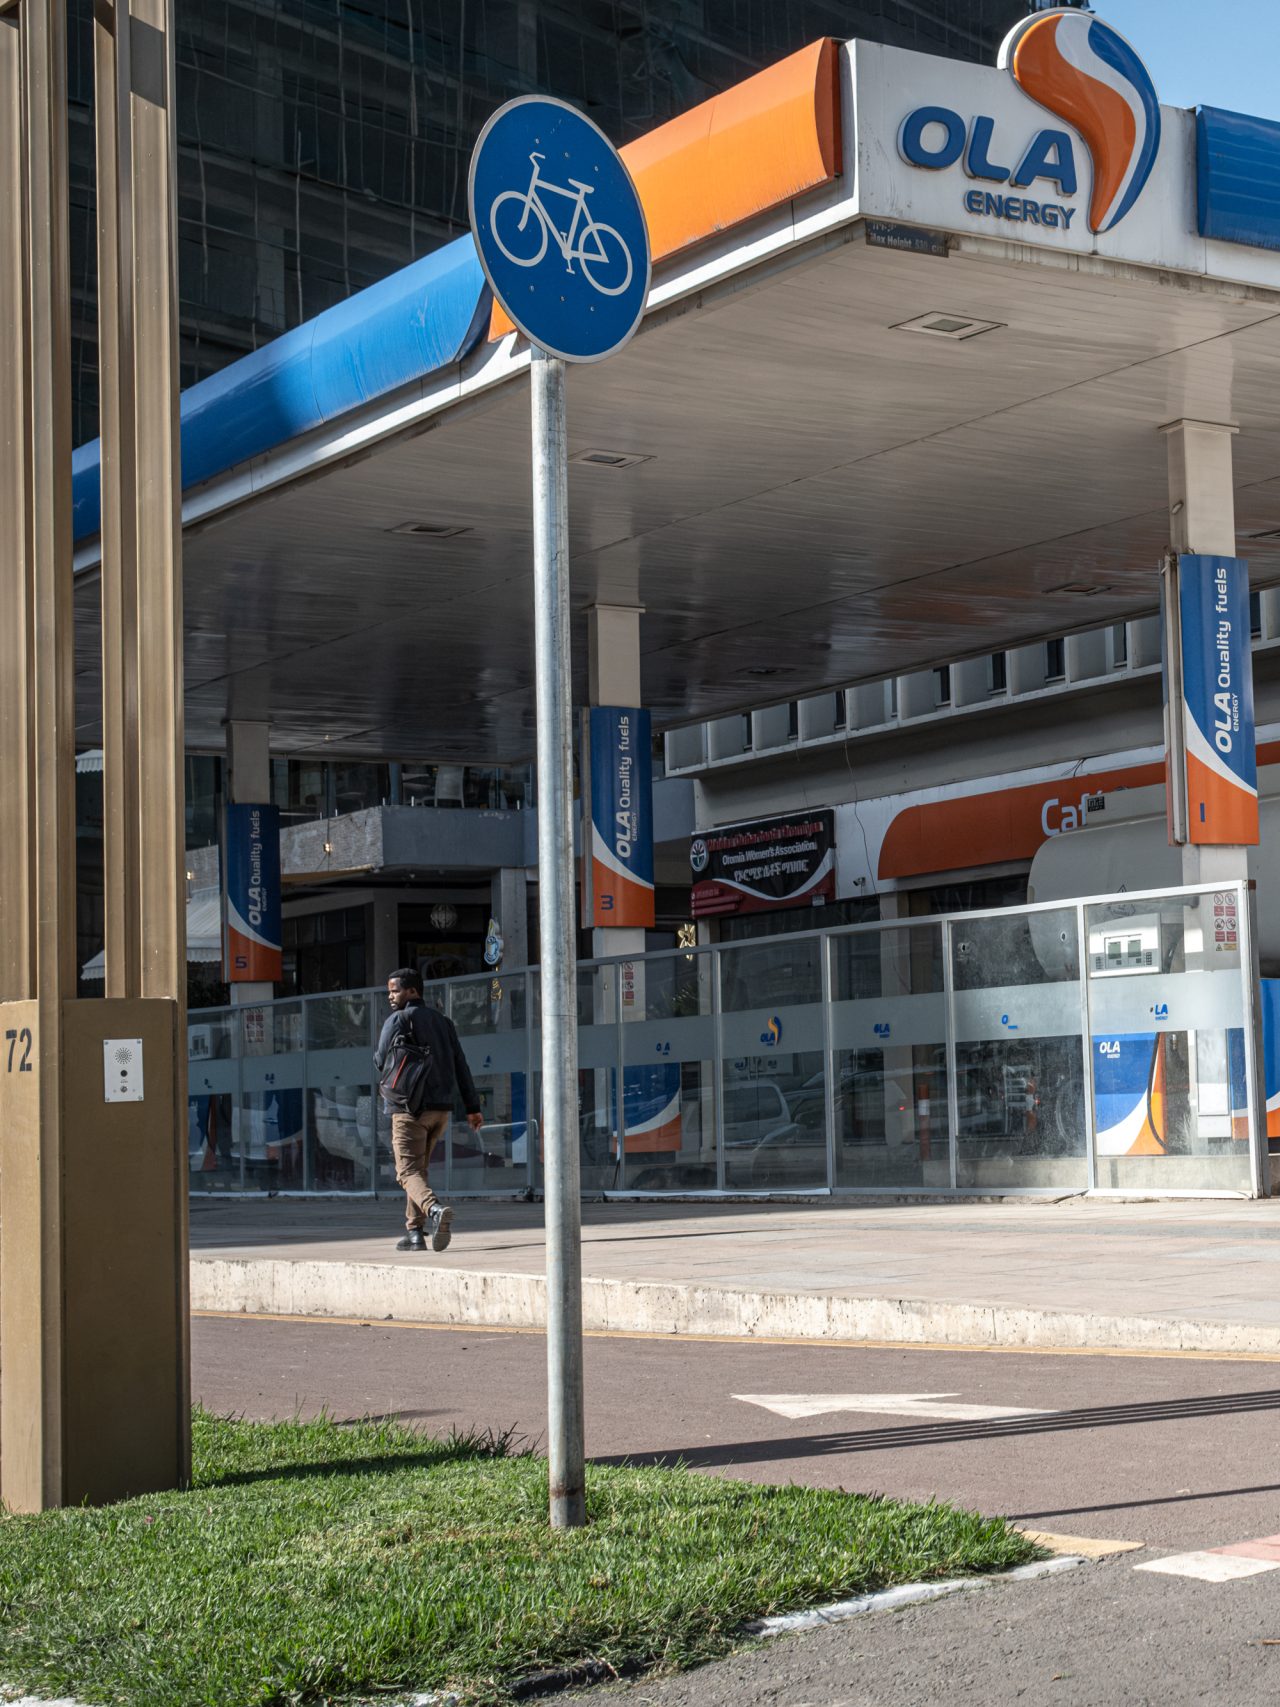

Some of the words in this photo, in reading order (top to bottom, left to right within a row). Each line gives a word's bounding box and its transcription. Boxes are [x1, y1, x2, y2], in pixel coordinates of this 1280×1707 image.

[898, 106, 1077, 196] OLA
[964, 189, 1075, 229] ENERGY
[1216, 568, 1227, 613] fuels
[1216, 620, 1232, 688] Quality
[618, 716, 629, 751] fuels
[1213, 692, 1233, 754] OLA
[619, 756, 632, 808] Quality
[250, 810, 260, 839] fuels
[616, 811, 631, 858] OLA
[1042, 790, 1102, 836] Caf
[250, 842, 263, 885] Quality
[722, 854, 745, 866] Oromia
[745, 847, 774, 861] Women's
[775, 841, 818, 857] Association
[248, 887, 261, 926] OLA
[600, 895, 614, 911] 3
[235, 956, 247, 969] 5
[6, 1028, 32, 1073] 72
[1100, 1041, 1120, 1053] OLA
